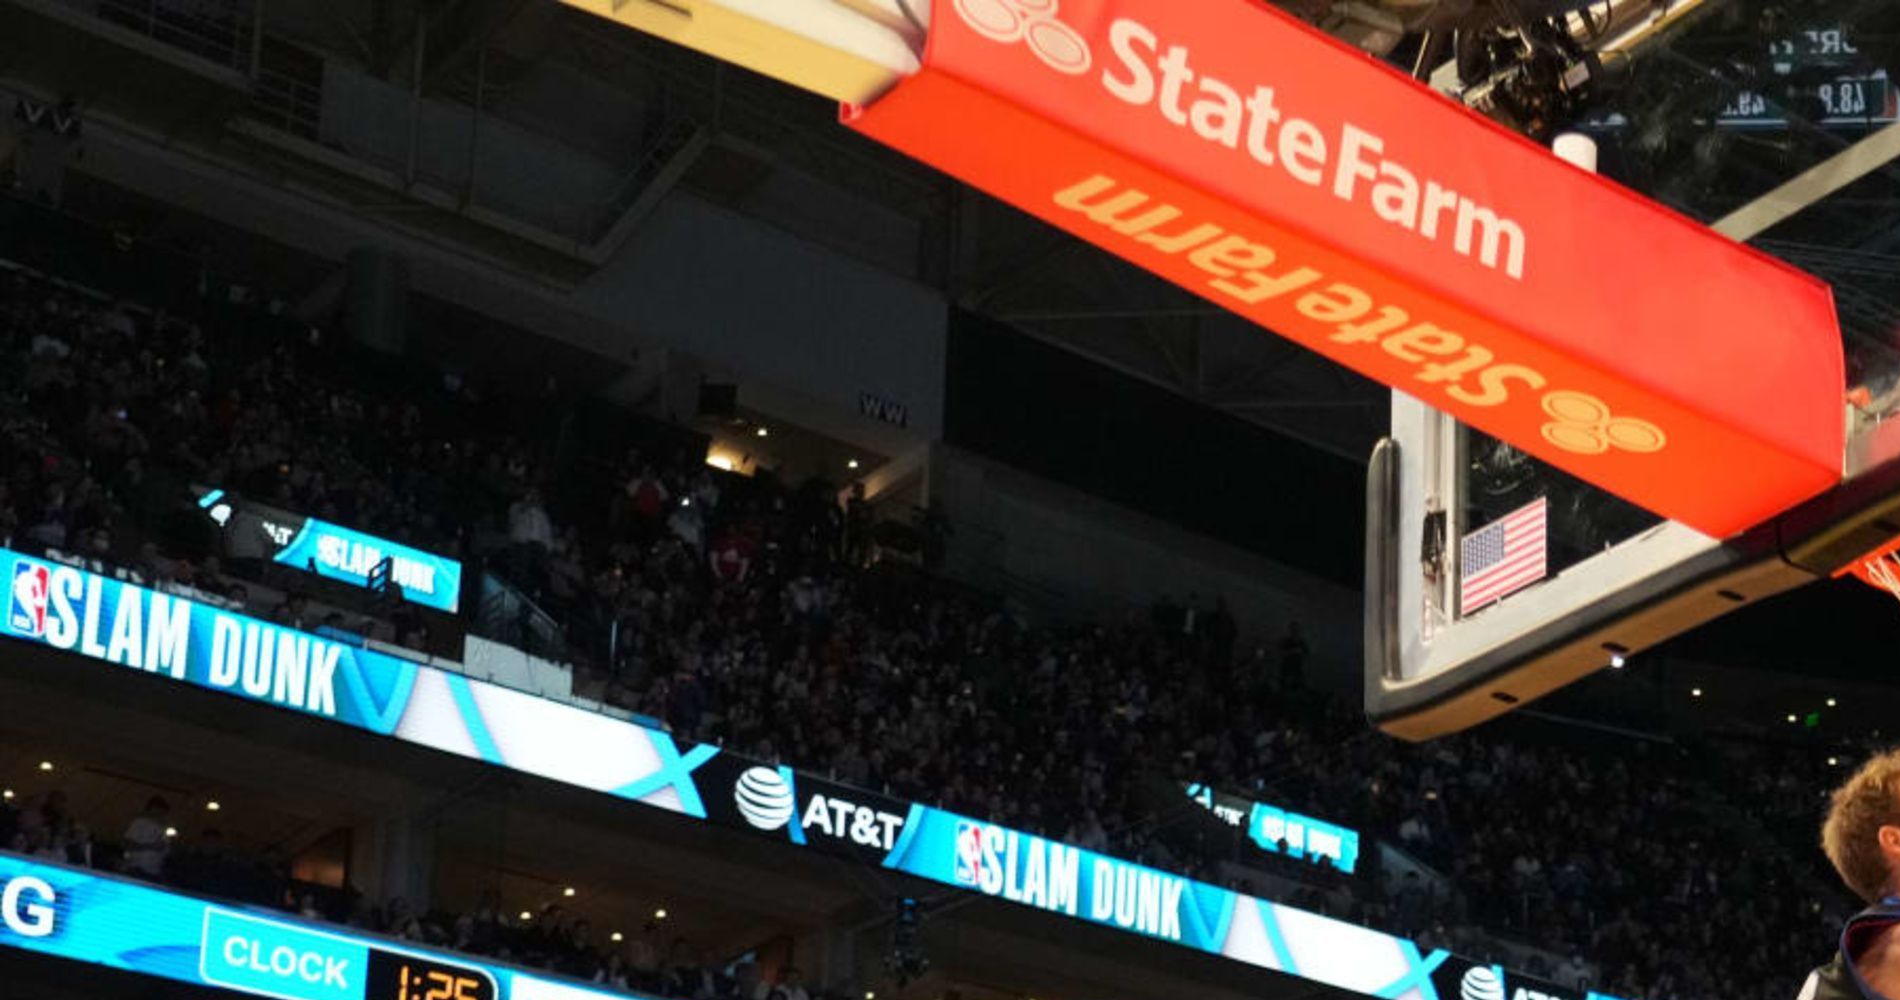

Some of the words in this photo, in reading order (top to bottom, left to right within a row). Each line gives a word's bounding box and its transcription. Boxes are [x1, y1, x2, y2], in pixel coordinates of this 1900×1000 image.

[45, 566, 192, 680] SLAM
[208, 614, 342, 717] DUNK
[802, 794, 905, 850] AT&T
[0, 875, 56, 938] G
[980, 824, 1080, 917] SLAM
[1093, 859, 1184, 940] DUNK
[223, 935, 349, 989] CLOCK
